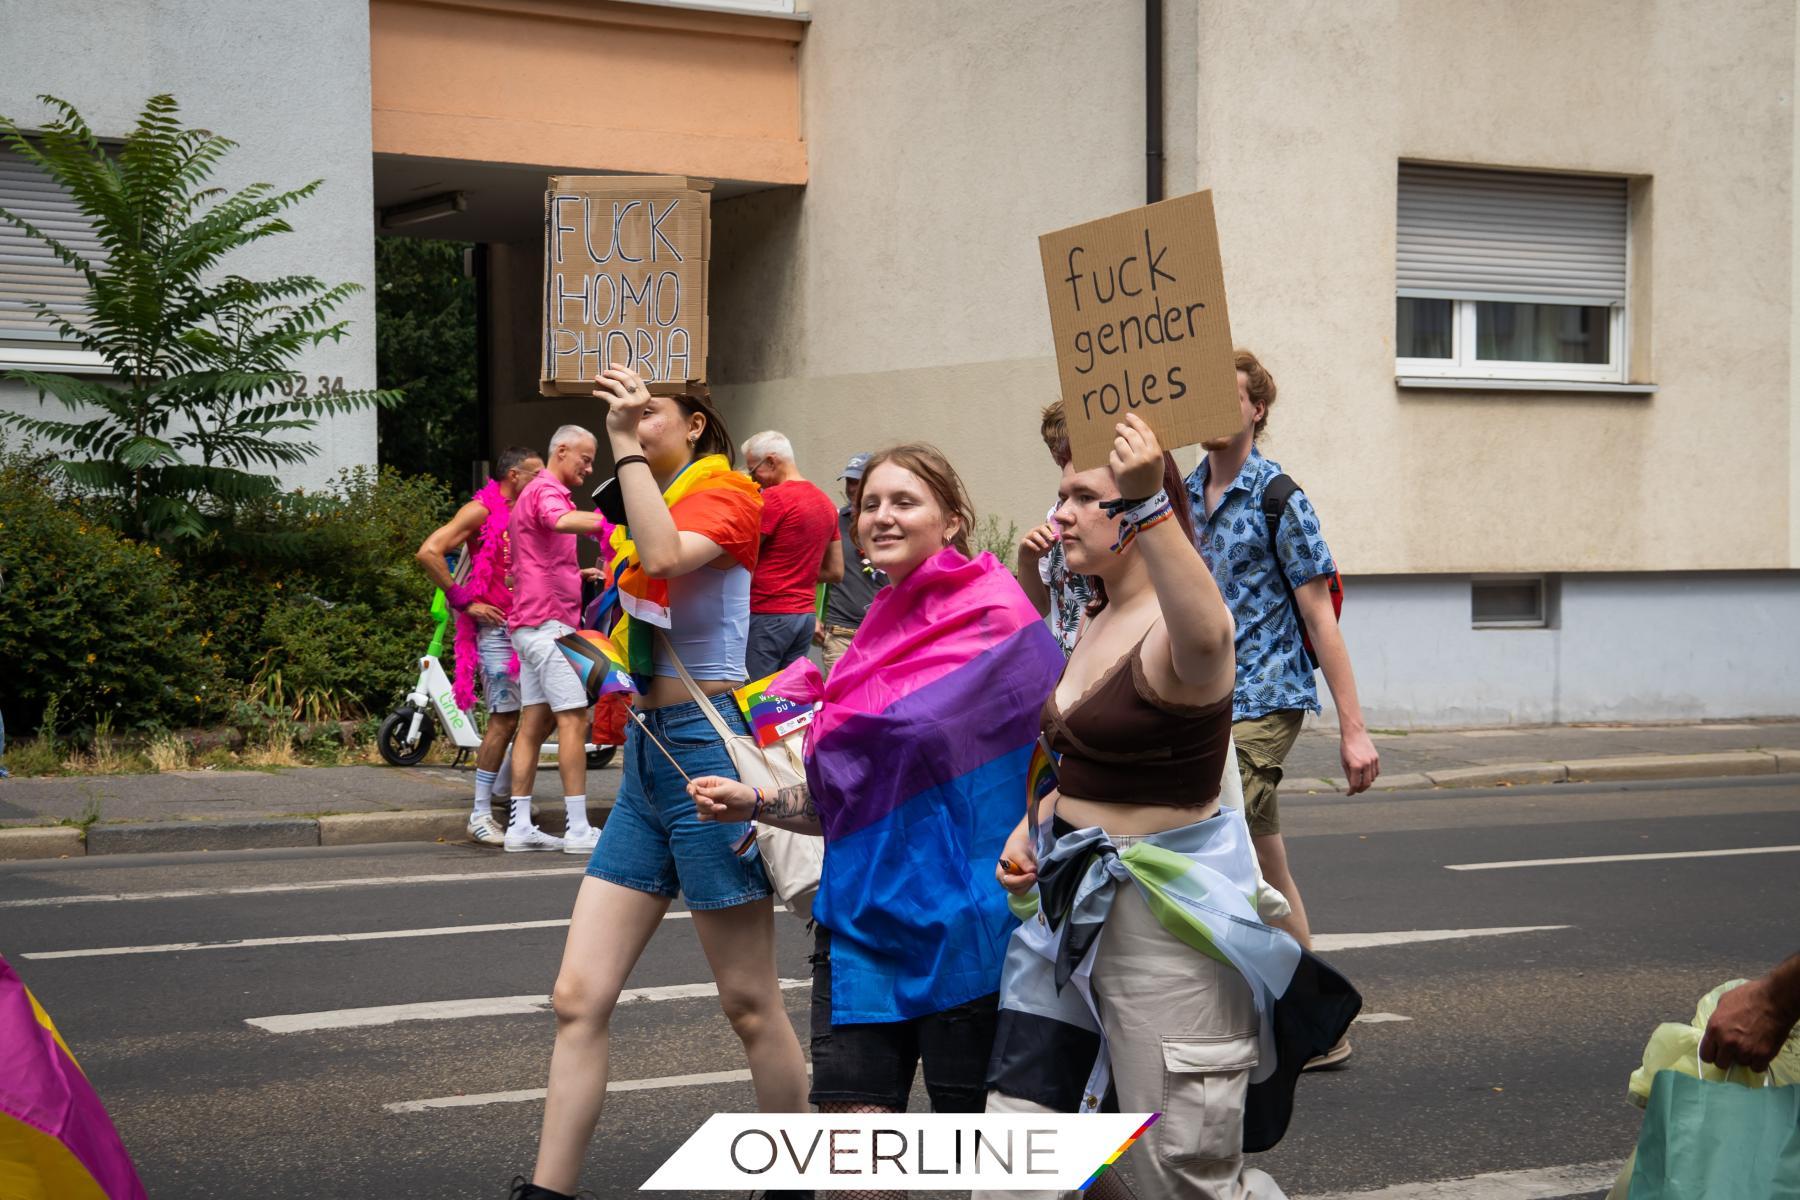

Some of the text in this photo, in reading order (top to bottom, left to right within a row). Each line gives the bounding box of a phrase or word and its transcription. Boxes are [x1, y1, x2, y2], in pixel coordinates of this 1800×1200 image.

[555, 195, 683, 265] FUCK
[1065, 228, 1177, 311] fuck
[557, 271, 681, 327] HOMO
[551, 327, 690, 385] PHOBIA
[1074, 296, 1206, 374] gender
[1082, 366, 1187, 421] roles
[439, 691, 464, 729] Lime
